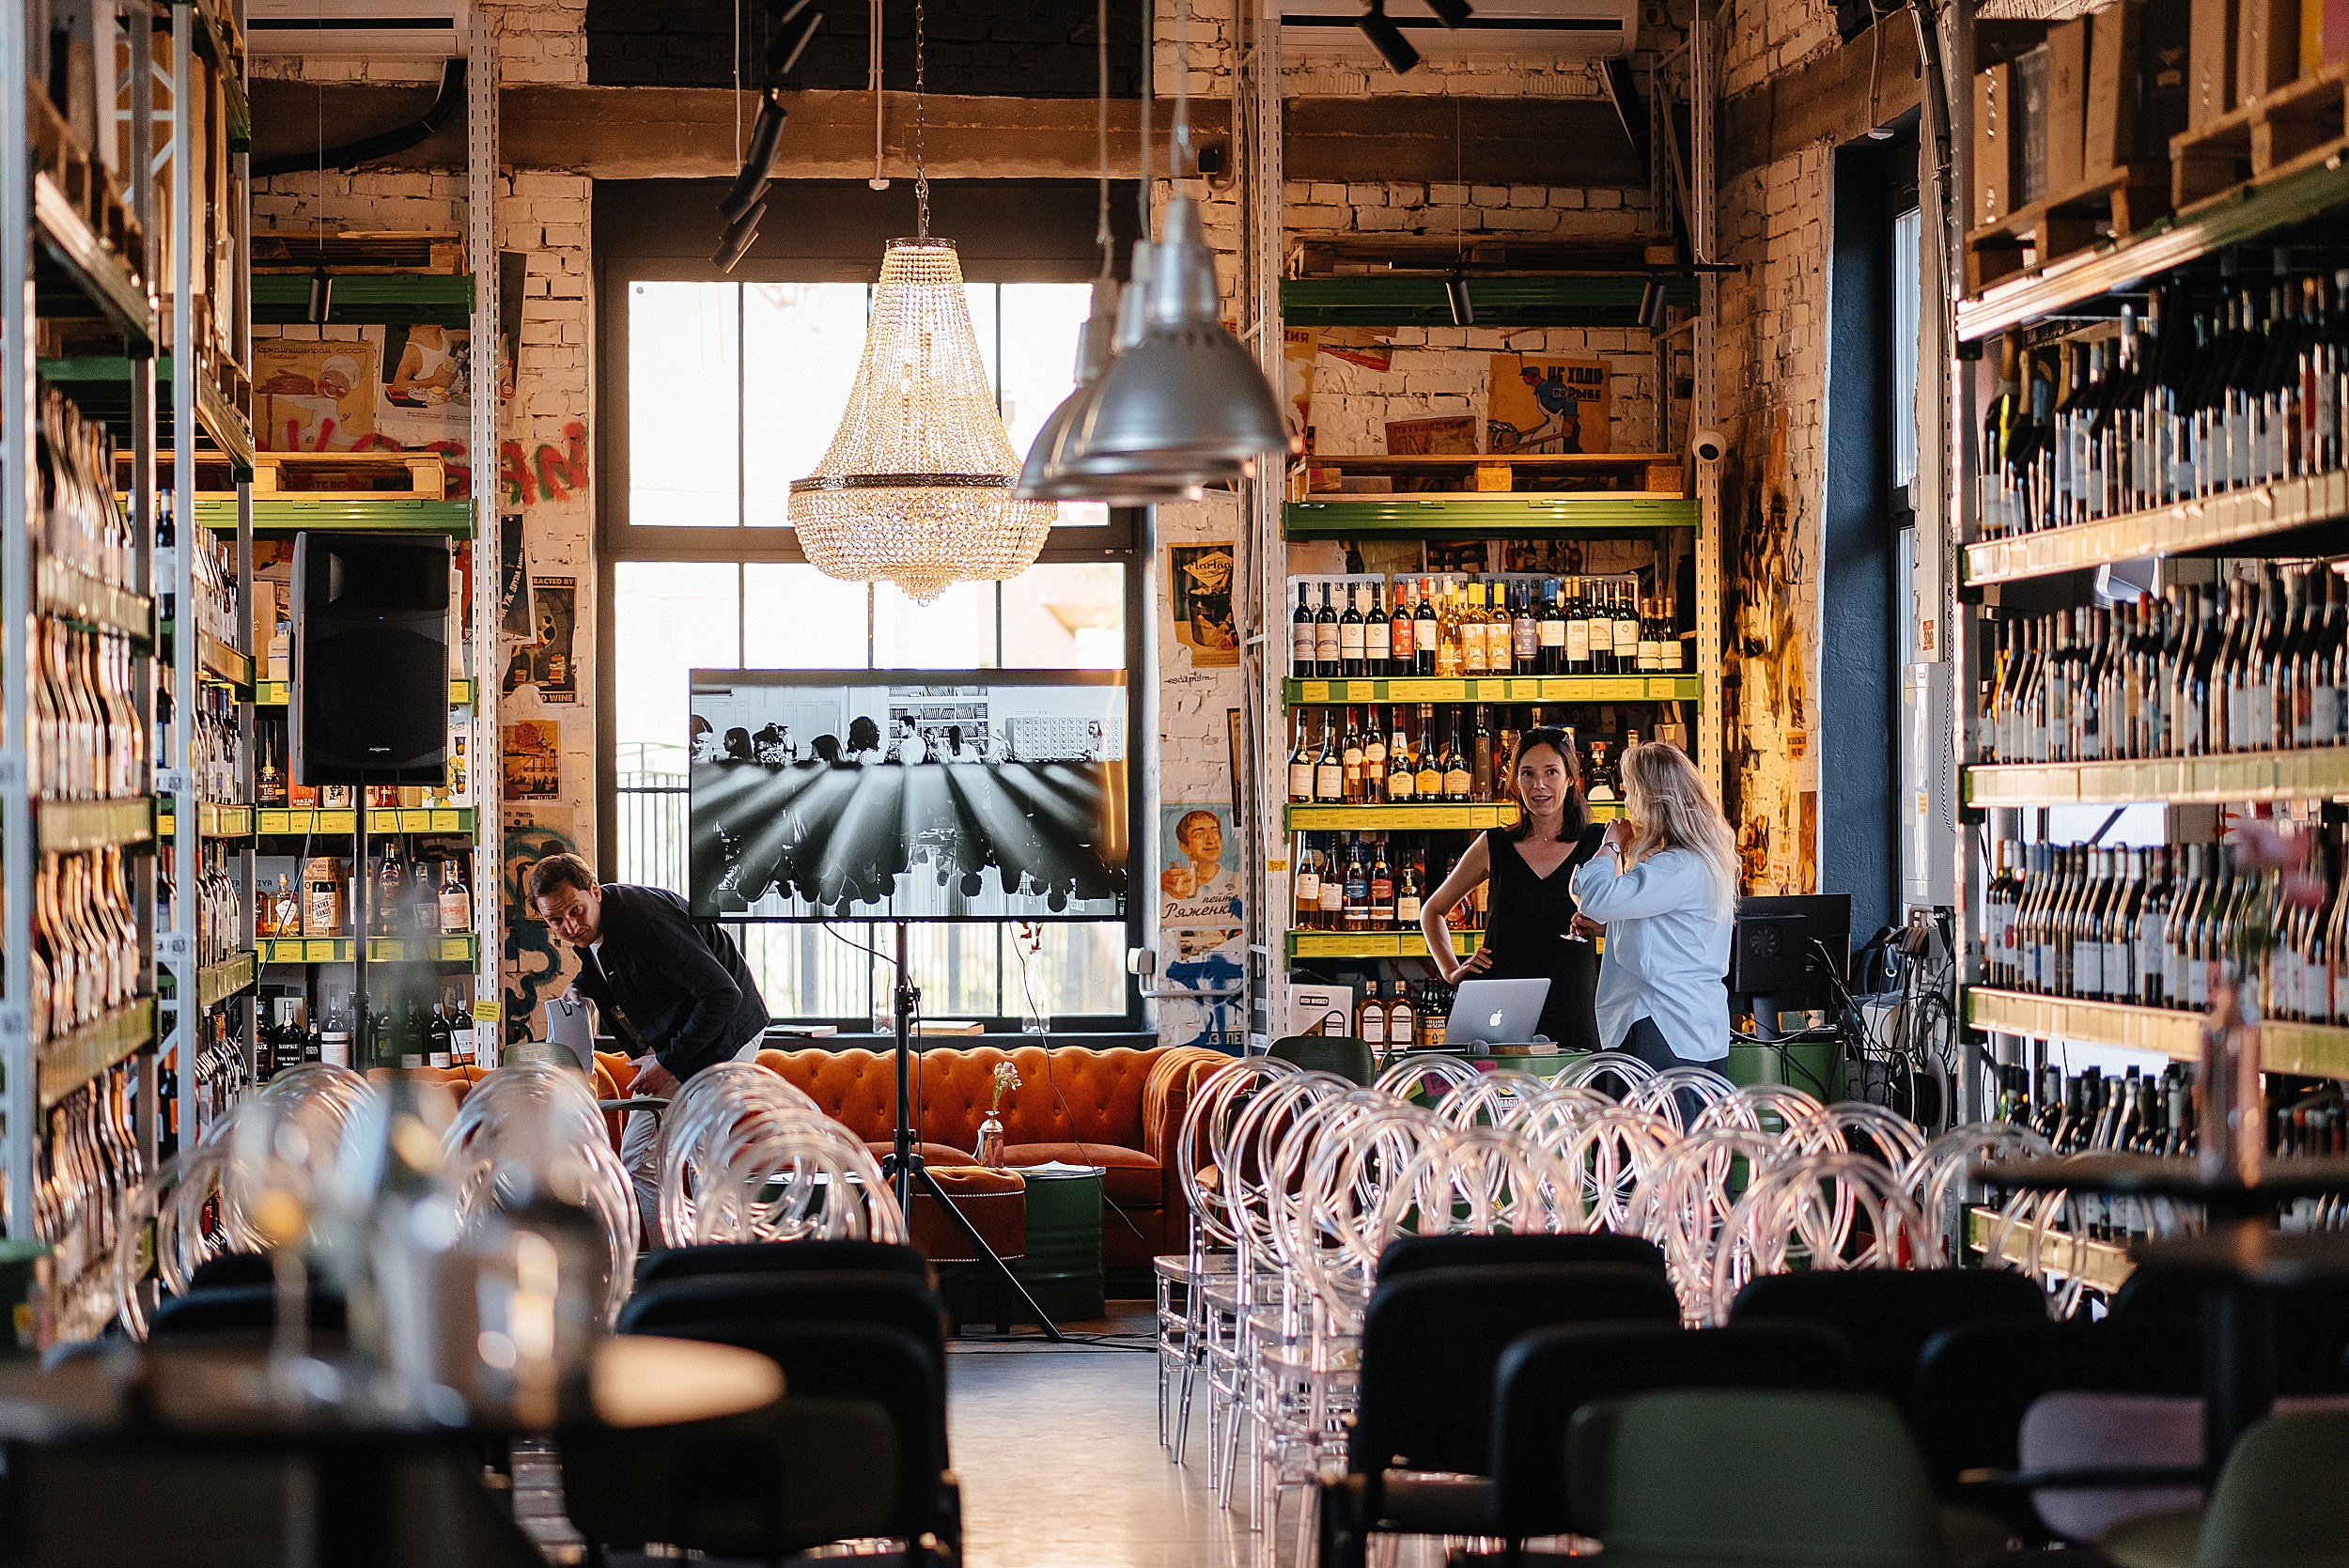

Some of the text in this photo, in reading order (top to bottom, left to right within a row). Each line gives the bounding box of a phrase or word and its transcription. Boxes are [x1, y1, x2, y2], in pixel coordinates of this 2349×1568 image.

[1547, 365, 1564, 382] НЕ
[549, 693, 573, 702] WINE
[1203, 893, 1238, 904] пейте
[1498, 1097, 1521, 1109] RAGIL
